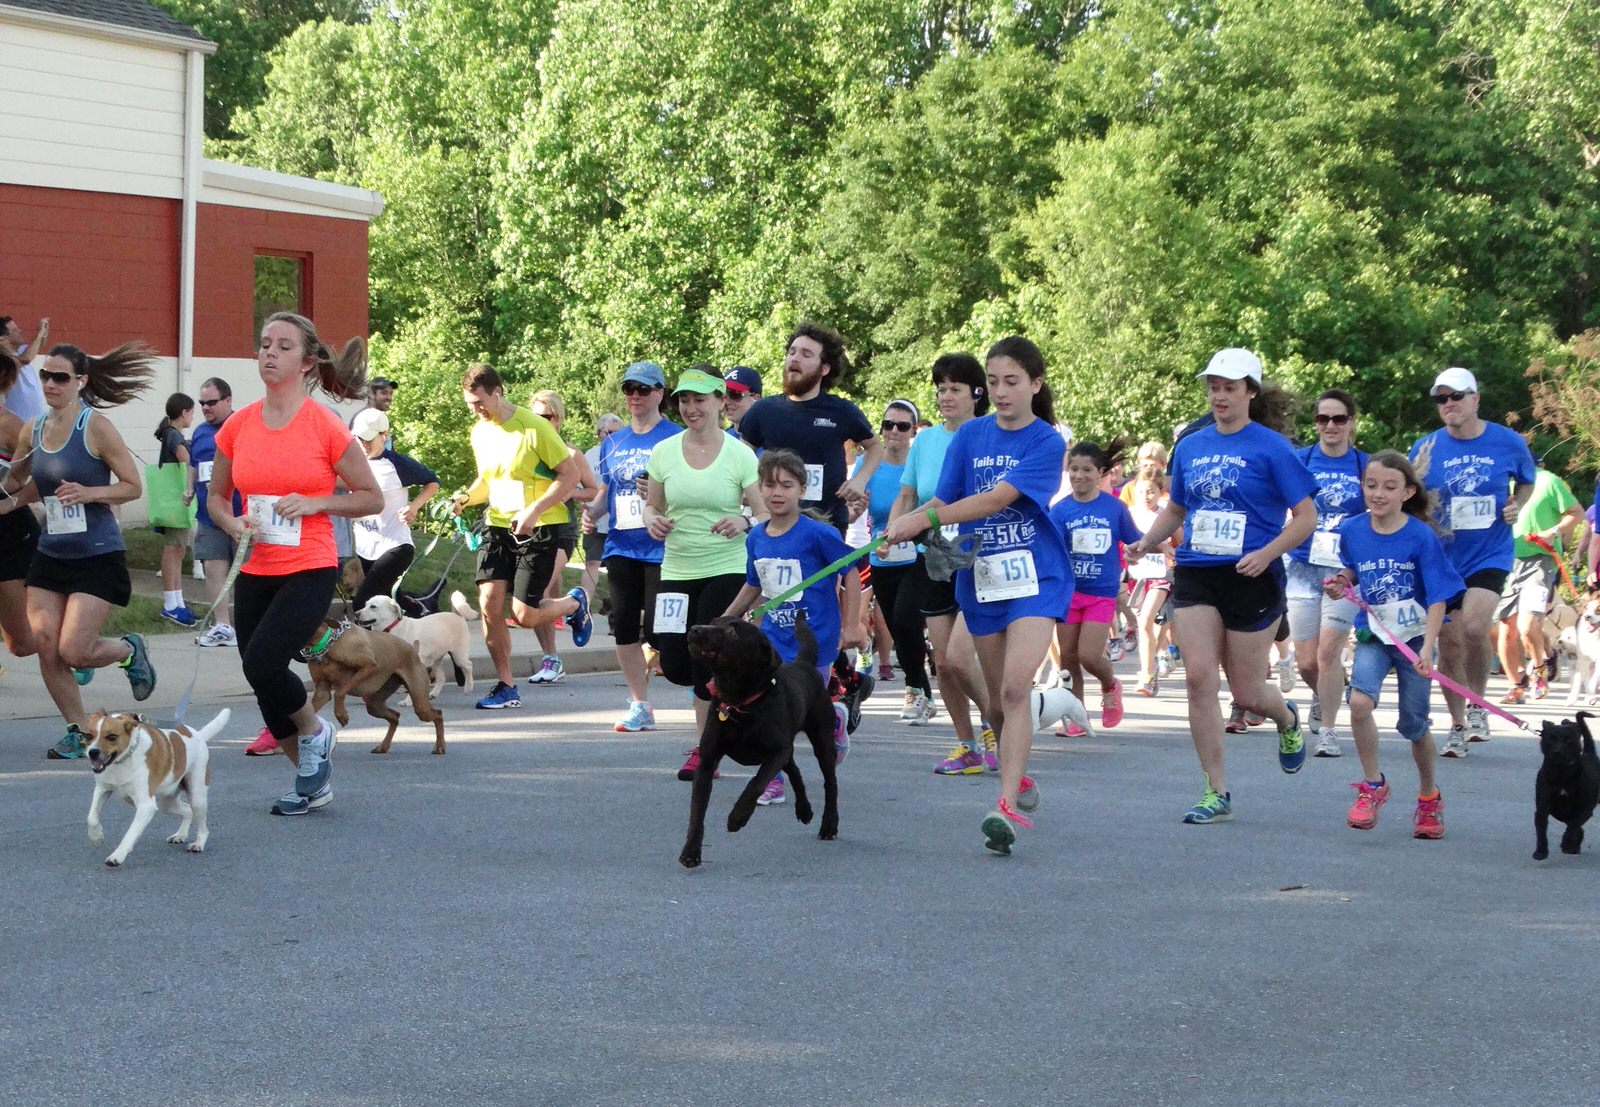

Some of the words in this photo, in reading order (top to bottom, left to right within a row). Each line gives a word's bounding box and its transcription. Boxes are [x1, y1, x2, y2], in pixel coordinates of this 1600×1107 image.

[973, 455, 995, 469] Tails
[996, 455, 1004, 467] &
[1004, 455, 1020, 468] Tra
[1191, 455, 1211, 468] Tails
[1212, 454, 1221, 464] &
[1222, 454, 1247, 468] Trails
[1442, 456, 1462, 469] Tails
[1462, 454, 1470, 464] &
[1470, 454, 1495, 466] Trails
[1472, 500, 1492, 517] 121
[1065, 518, 1083, 530] Tails
[1089, 515, 1110, 527] Trails
[1214, 517, 1241, 541] 145
[996, 523, 1021, 545] 5K
[1095, 533, 1108, 549] 57
[1001, 555, 1030, 582] 151
[1074, 563, 1090, 575] 5K
[1357, 560, 1377, 572] Tails
[1378, 558, 1386, 569] &
[1386, 558, 1416, 571] Trails
[776, 565, 793, 586] 77
[662, 598, 684, 618] 137
[1397, 604, 1420, 628] 44
